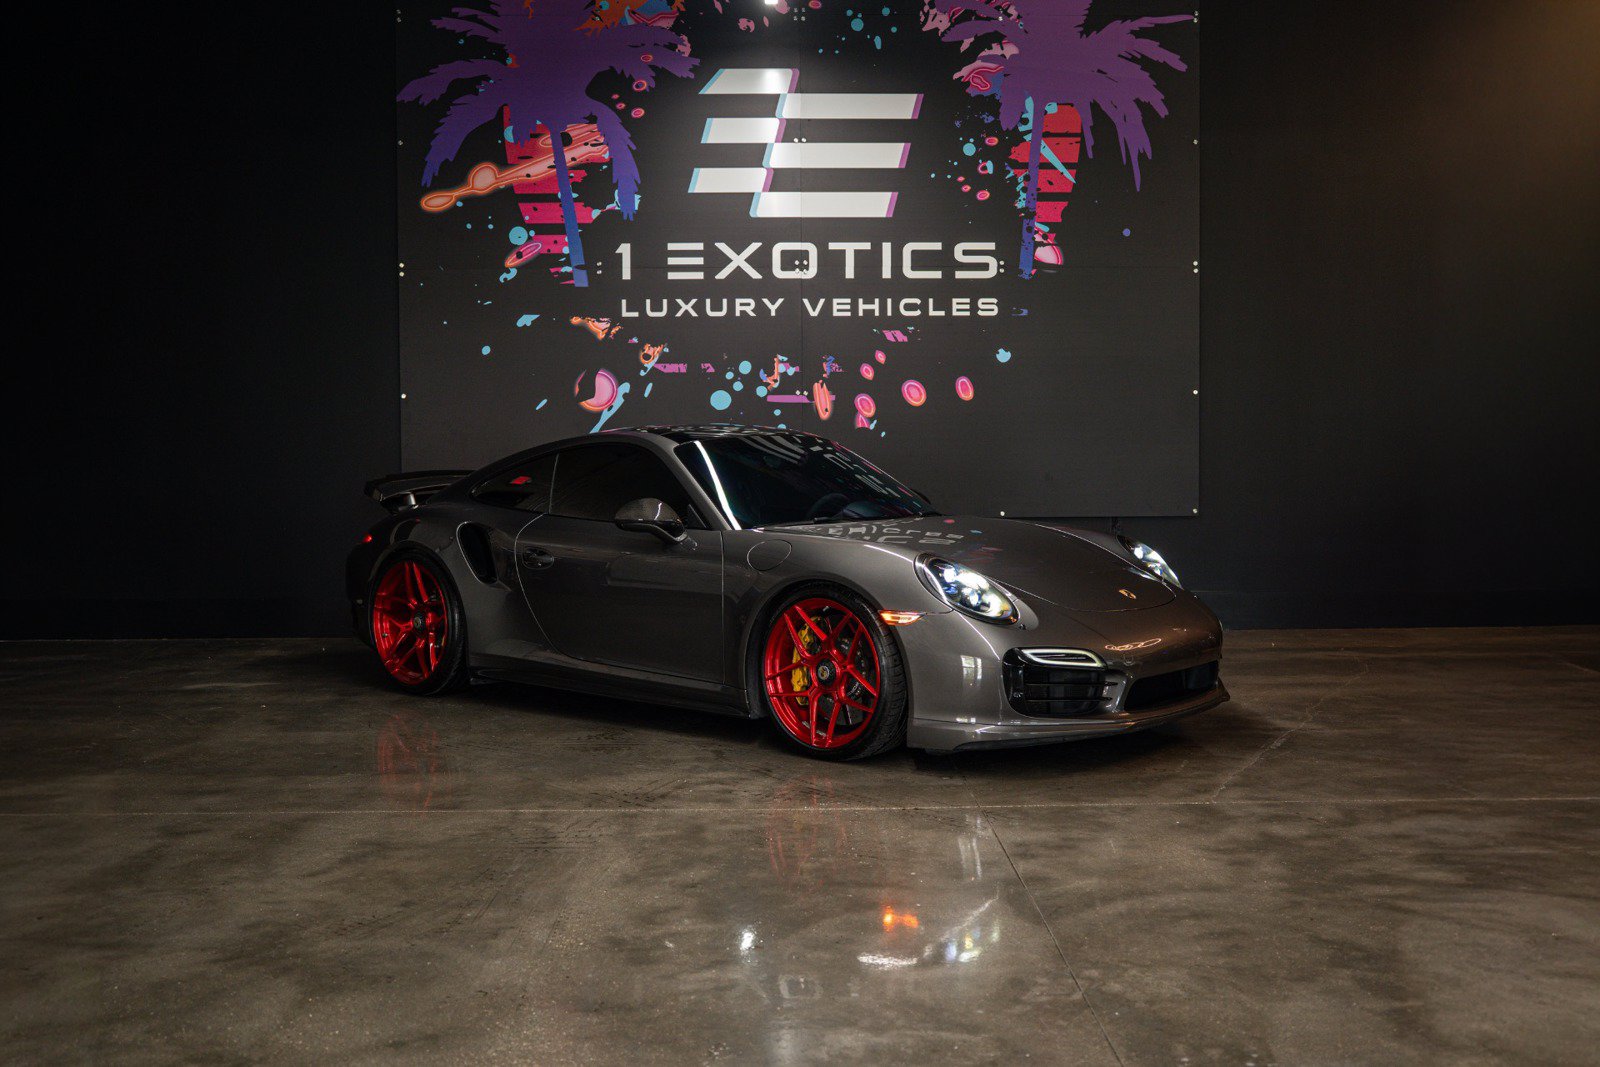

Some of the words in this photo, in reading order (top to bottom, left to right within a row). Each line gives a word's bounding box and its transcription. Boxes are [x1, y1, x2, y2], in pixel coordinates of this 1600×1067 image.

[615, 243, 631, 280] 1
[667, 242, 998, 279] EXOTICS
[621, 298, 785, 317] LUXURY
[802, 298, 999, 317] VEHICLES
